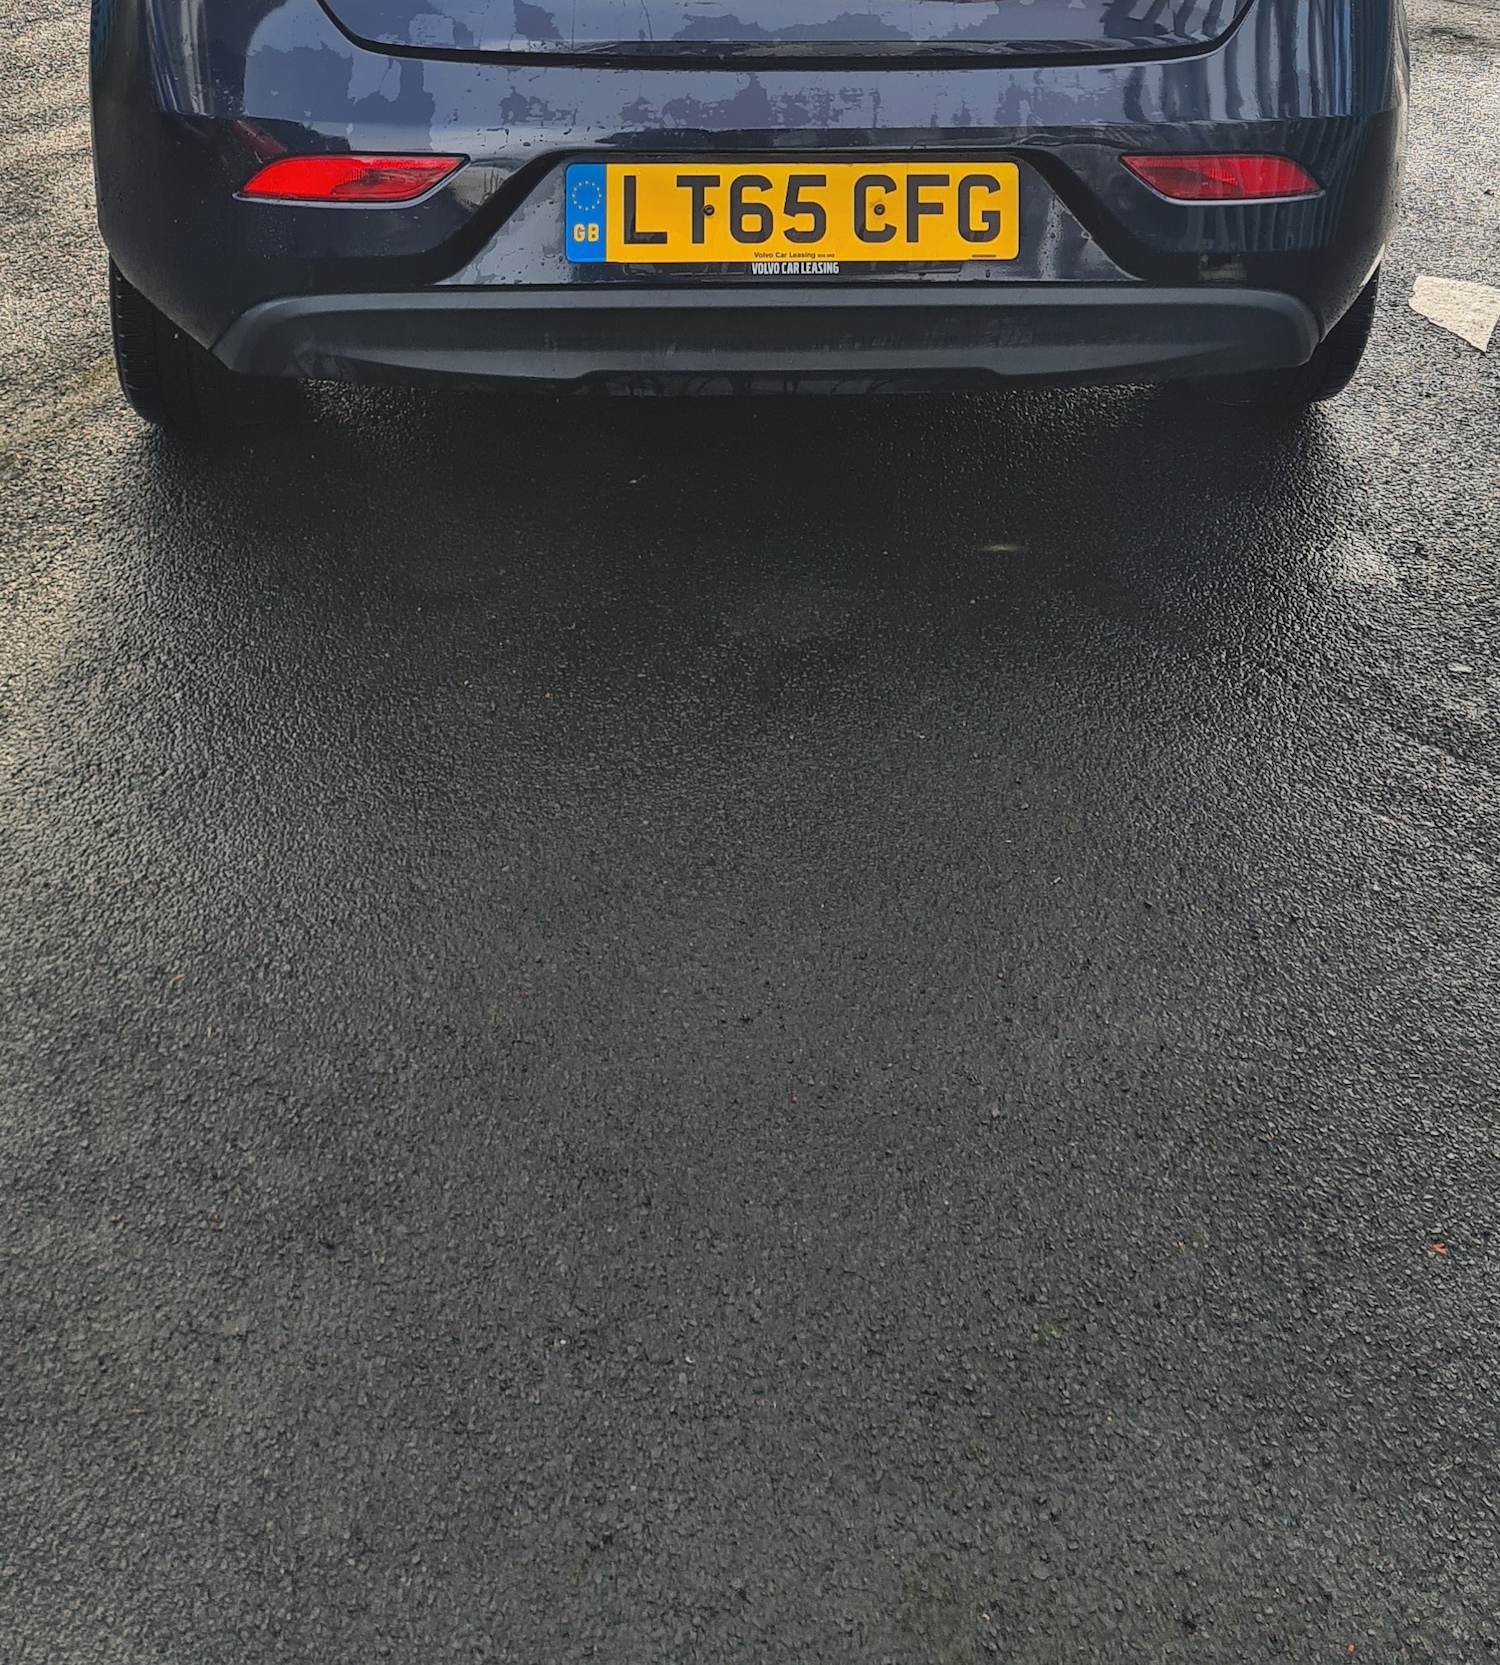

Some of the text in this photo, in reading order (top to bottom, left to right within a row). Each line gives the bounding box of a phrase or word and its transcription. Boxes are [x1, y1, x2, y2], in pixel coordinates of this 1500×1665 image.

[622, 174, 1001, 246] LT65 CFG
[572, 223, 600, 244] GB
[789, 251, 816, 259] Leasing
[751, 261, 840, 275] VOLVO CAR LEASING
